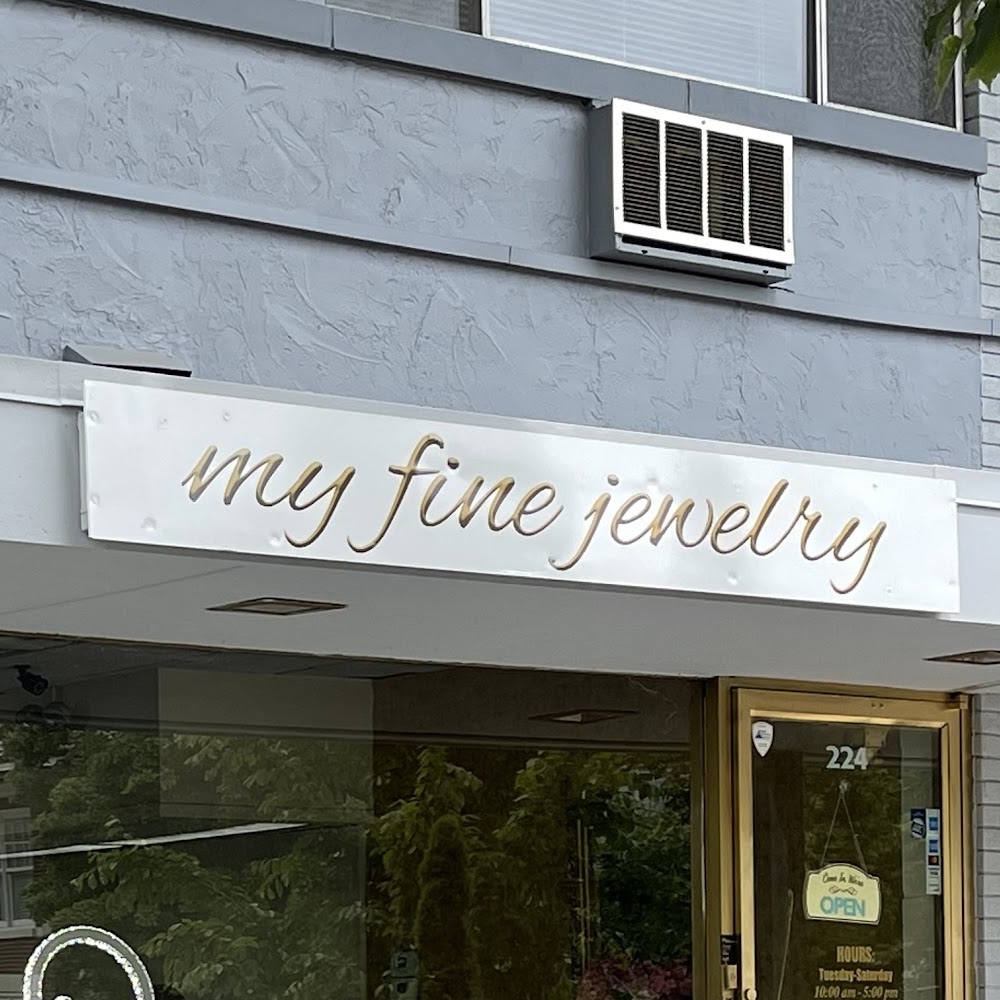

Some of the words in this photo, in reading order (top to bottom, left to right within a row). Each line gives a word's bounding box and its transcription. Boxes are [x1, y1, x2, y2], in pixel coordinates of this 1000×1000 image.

[181, 443, 357, 547] my
[346, 432, 564, 553] fine
[548, 473, 887, 595] jewelry
[825, 745, 869, 770] 224
[820, 896, 866, 918] OPEN
[836, 945, 876, 963] HOURS:
[814, 985, 841, 998] 10:00
[840, 988, 857, 998] am
[862, 985, 884, 998] 5:00
